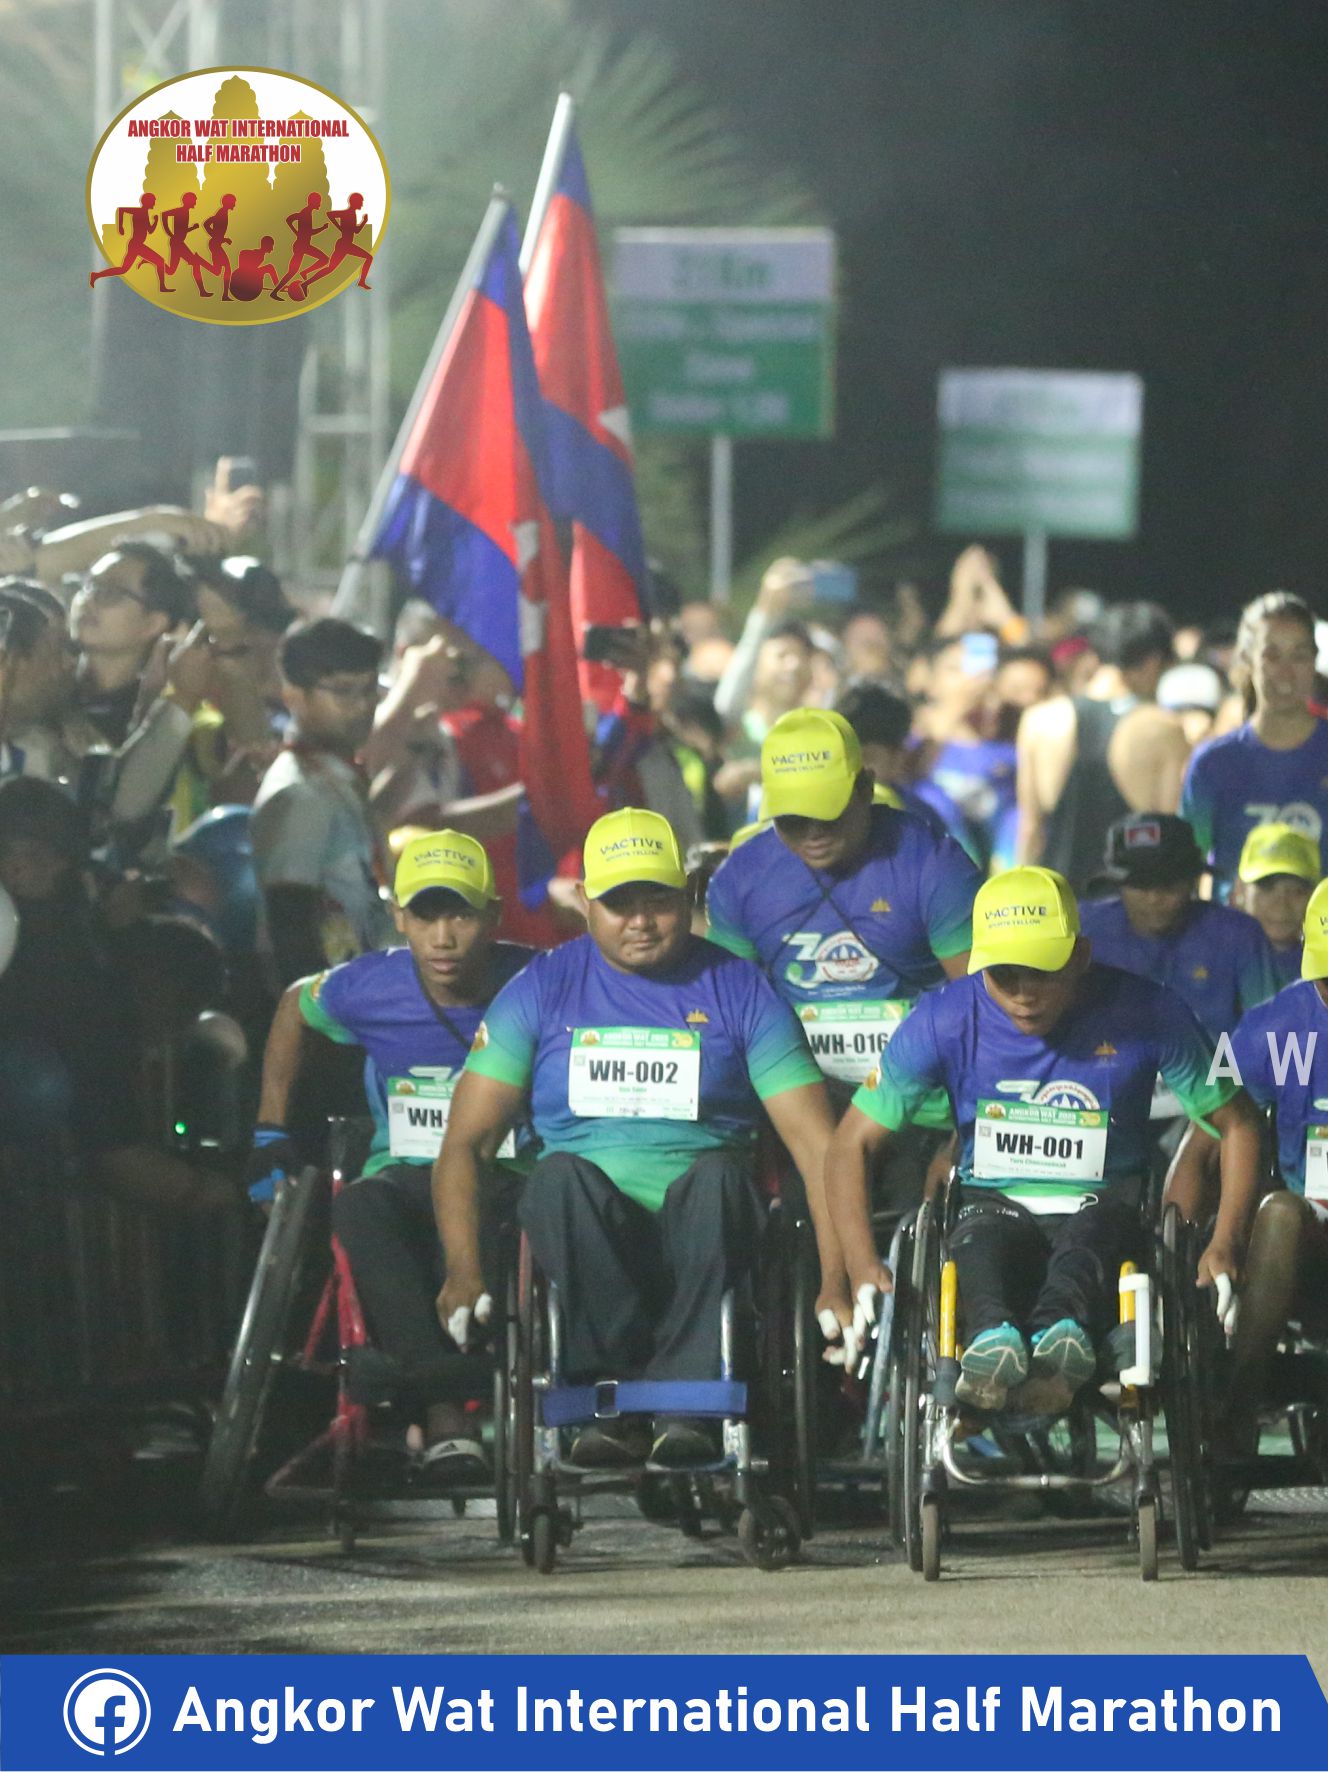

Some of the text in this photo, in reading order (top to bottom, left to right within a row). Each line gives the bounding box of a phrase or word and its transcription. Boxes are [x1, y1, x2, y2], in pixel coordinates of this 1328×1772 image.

[600, 837, 663, 855] V-ACTIVE
[984, 905, 1047, 920] V-ACTIVE
[810, 1032, 889, 1055] WH-016
[588, 1058, 679, 1084] WH-002
[407, 1107, 448, 1128] WH-
[995, 1131, 1084, 1160] WH-001
